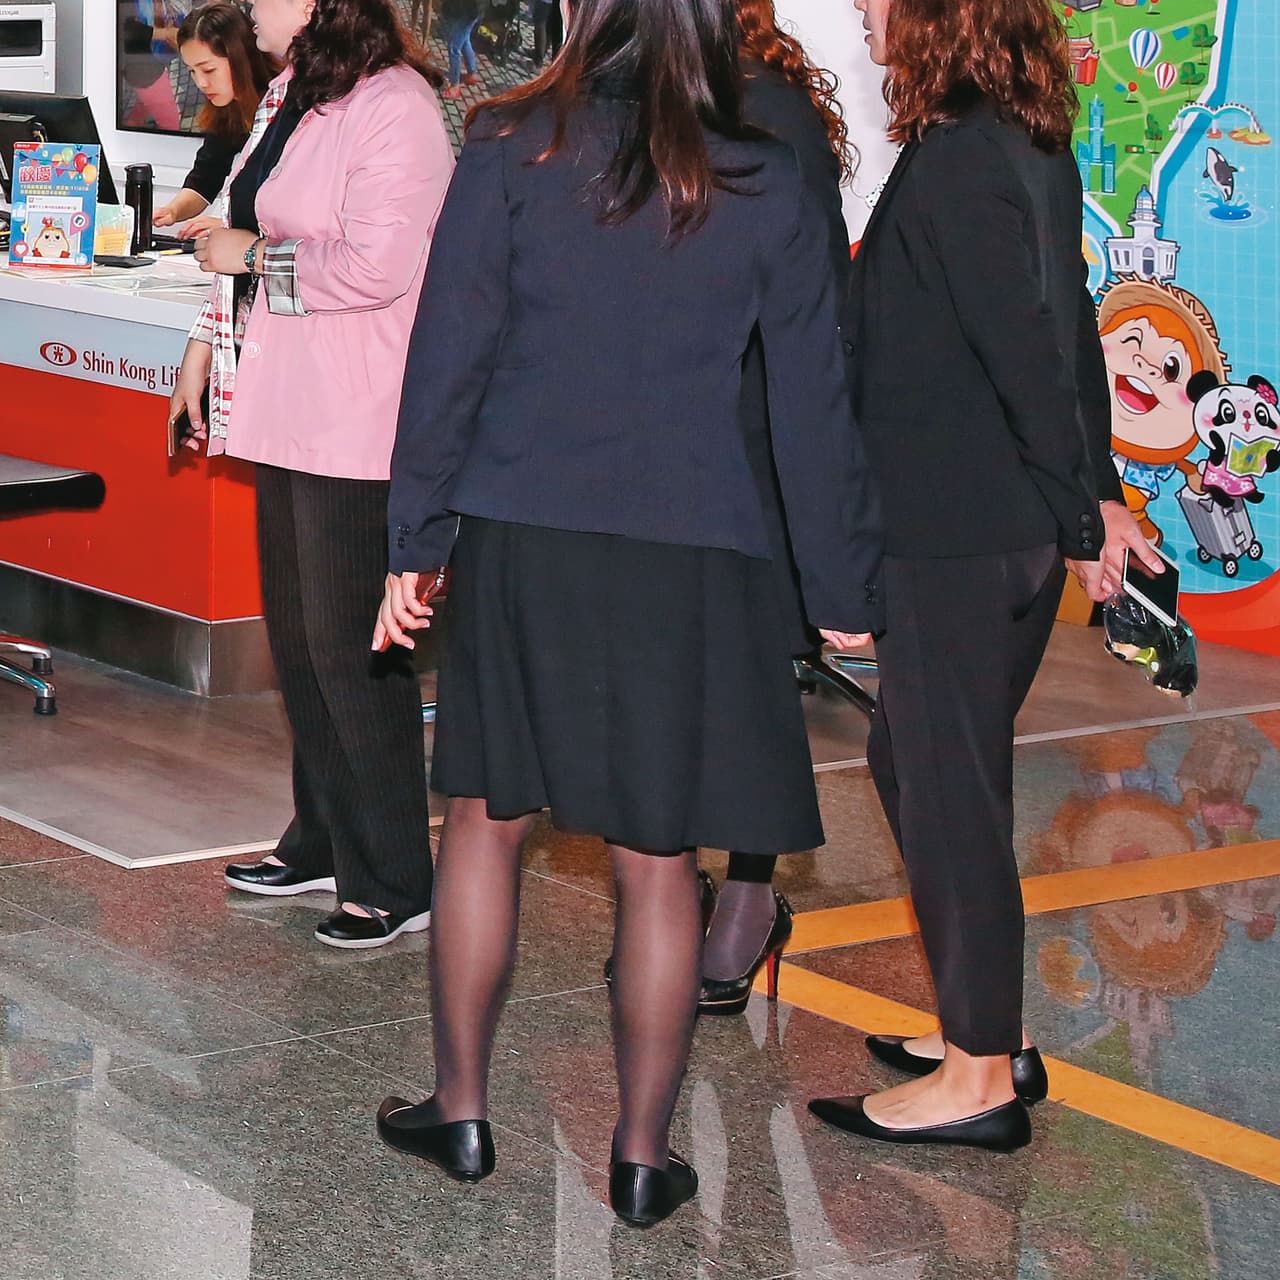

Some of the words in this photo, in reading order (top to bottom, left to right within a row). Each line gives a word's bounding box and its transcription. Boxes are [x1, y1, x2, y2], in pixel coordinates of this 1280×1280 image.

[82, 350, 115, 375] Shin
[119, 357, 157, 390] Kong
[161, 365, 182, 388] Lif
